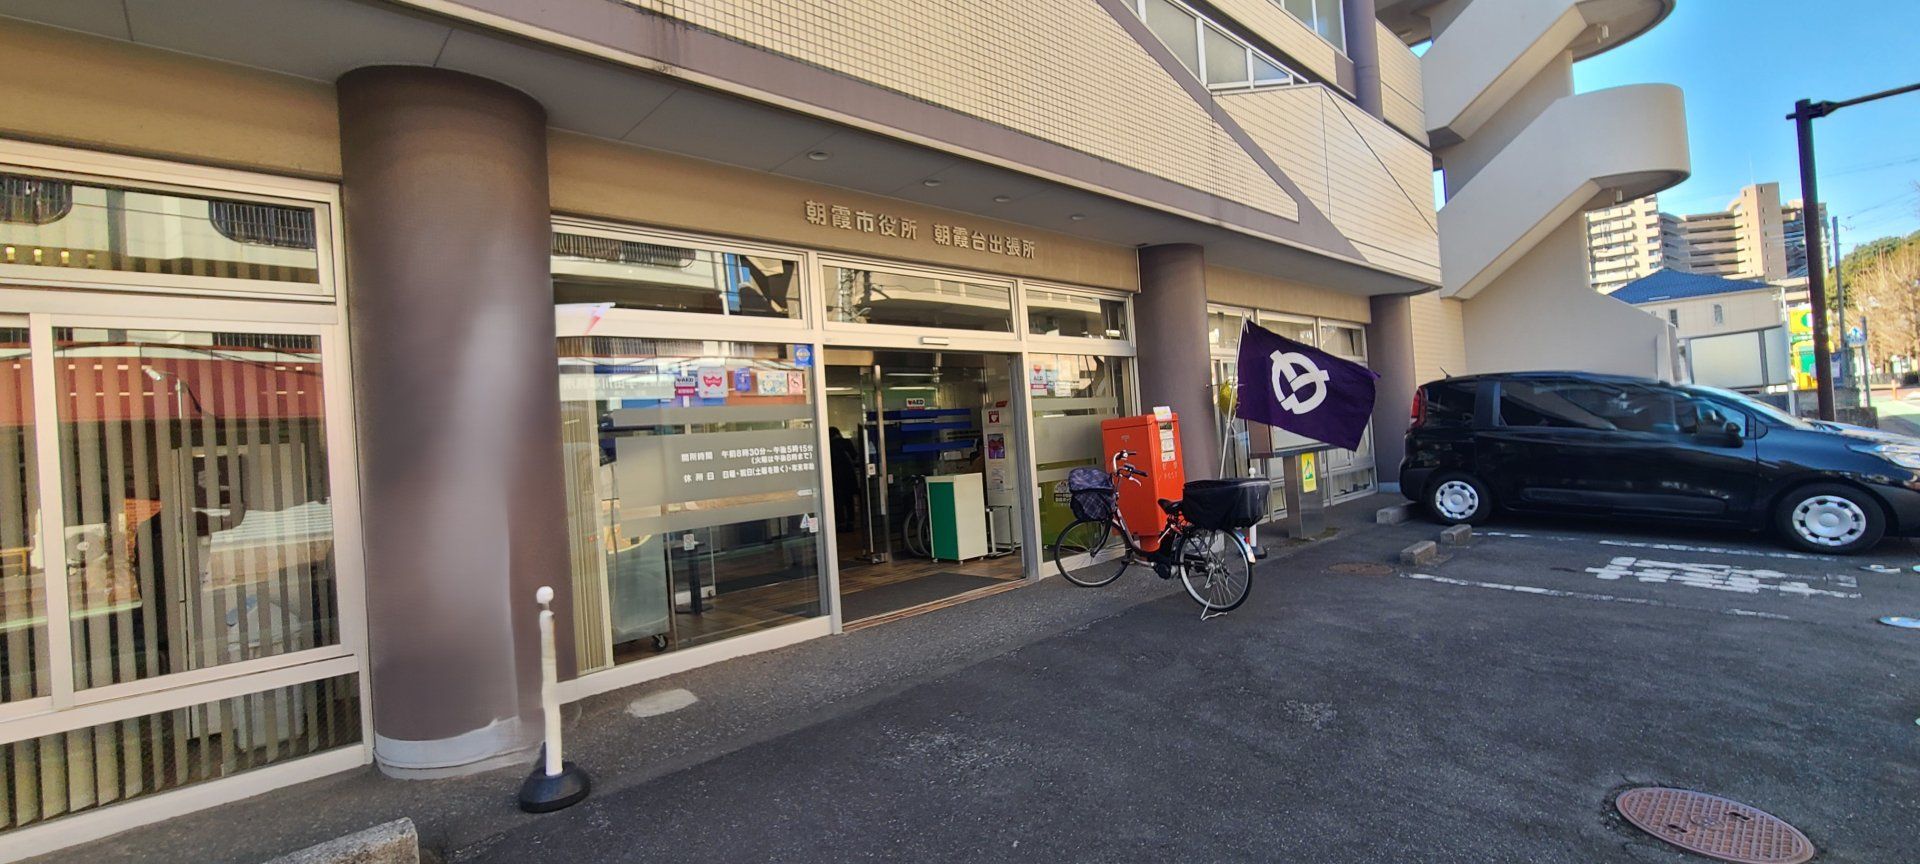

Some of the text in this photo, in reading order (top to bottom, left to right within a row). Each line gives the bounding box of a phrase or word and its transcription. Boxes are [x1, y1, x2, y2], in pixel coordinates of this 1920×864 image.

[805, 200, 1036, 259] 朝霞市役所 朝霞台出張所
[681, 451, 713, 462] 開所時間
